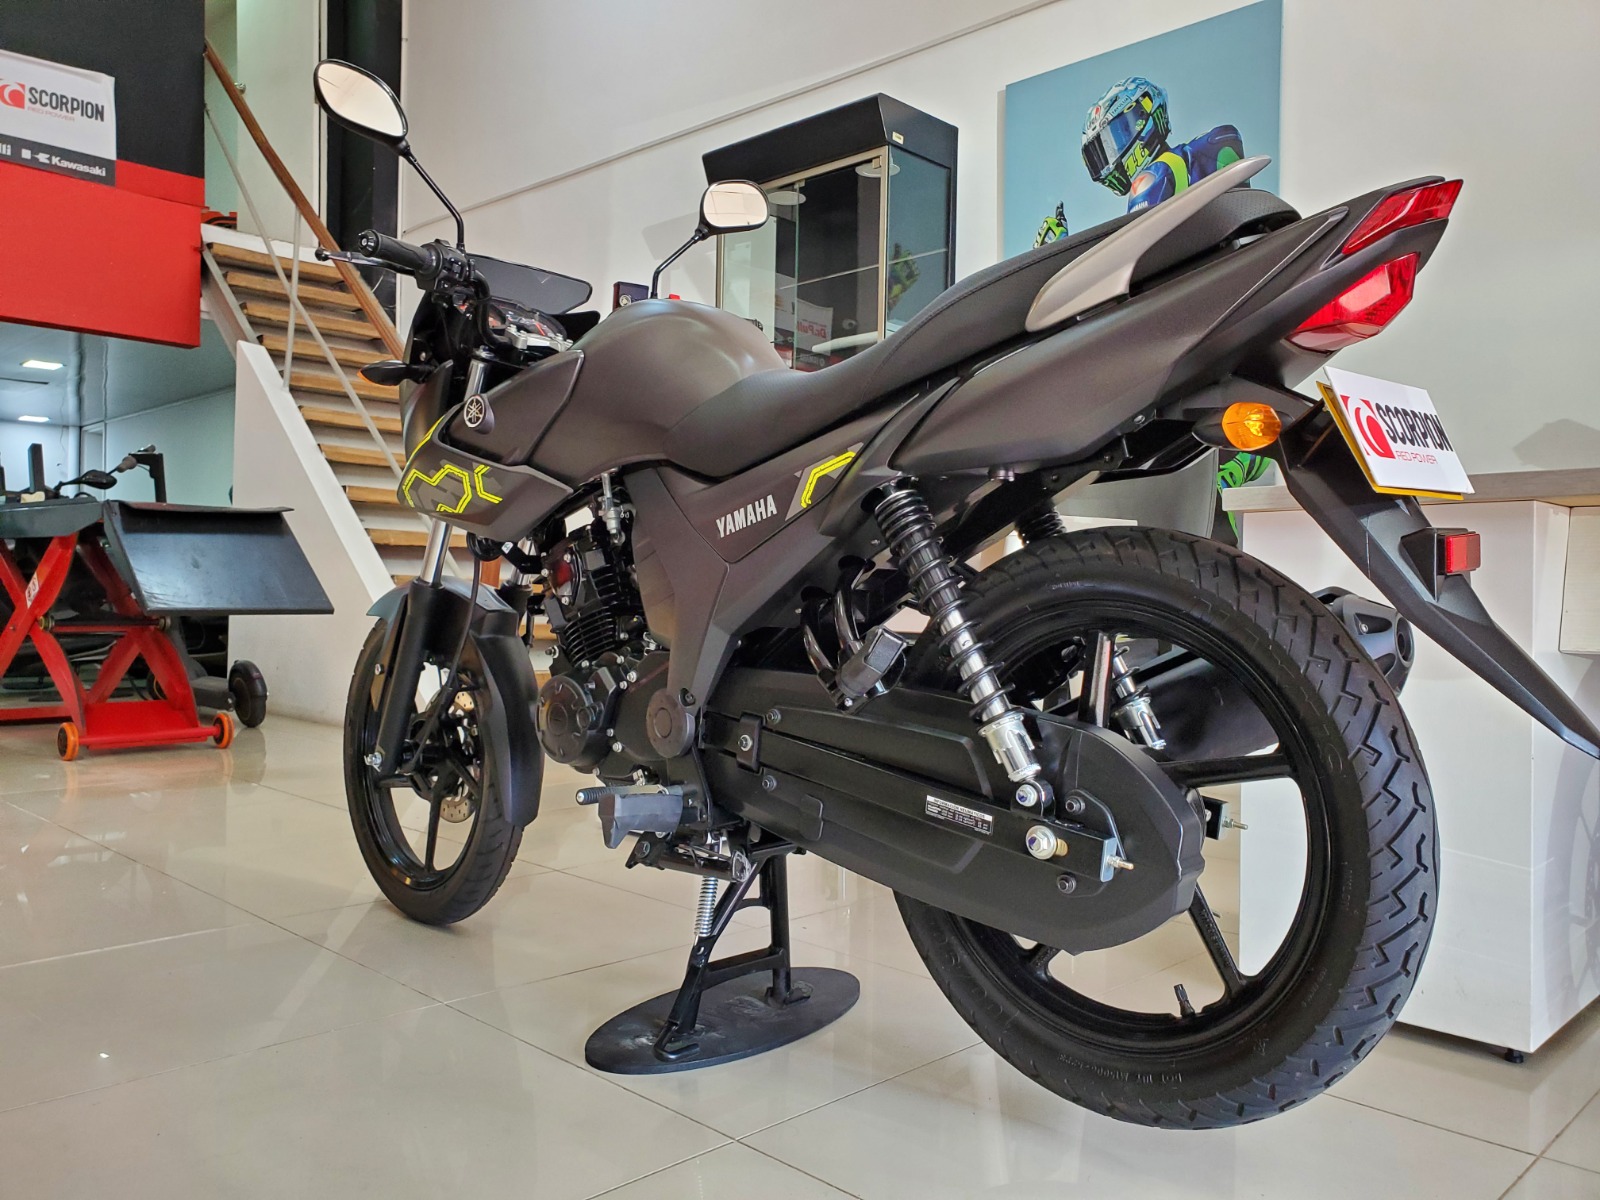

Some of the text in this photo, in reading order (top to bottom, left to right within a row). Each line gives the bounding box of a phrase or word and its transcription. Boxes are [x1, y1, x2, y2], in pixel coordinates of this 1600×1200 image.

[28, 87, 105, 122] SCORPION
[52, 155, 106, 177] Kawasaki
[1124, 142, 1150, 178] 46
[1375, 402, 1454, 452] SCORPION
[1395, 450, 1438, 464] RED POWER
[715, 494, 778, 539] YAMAHA
